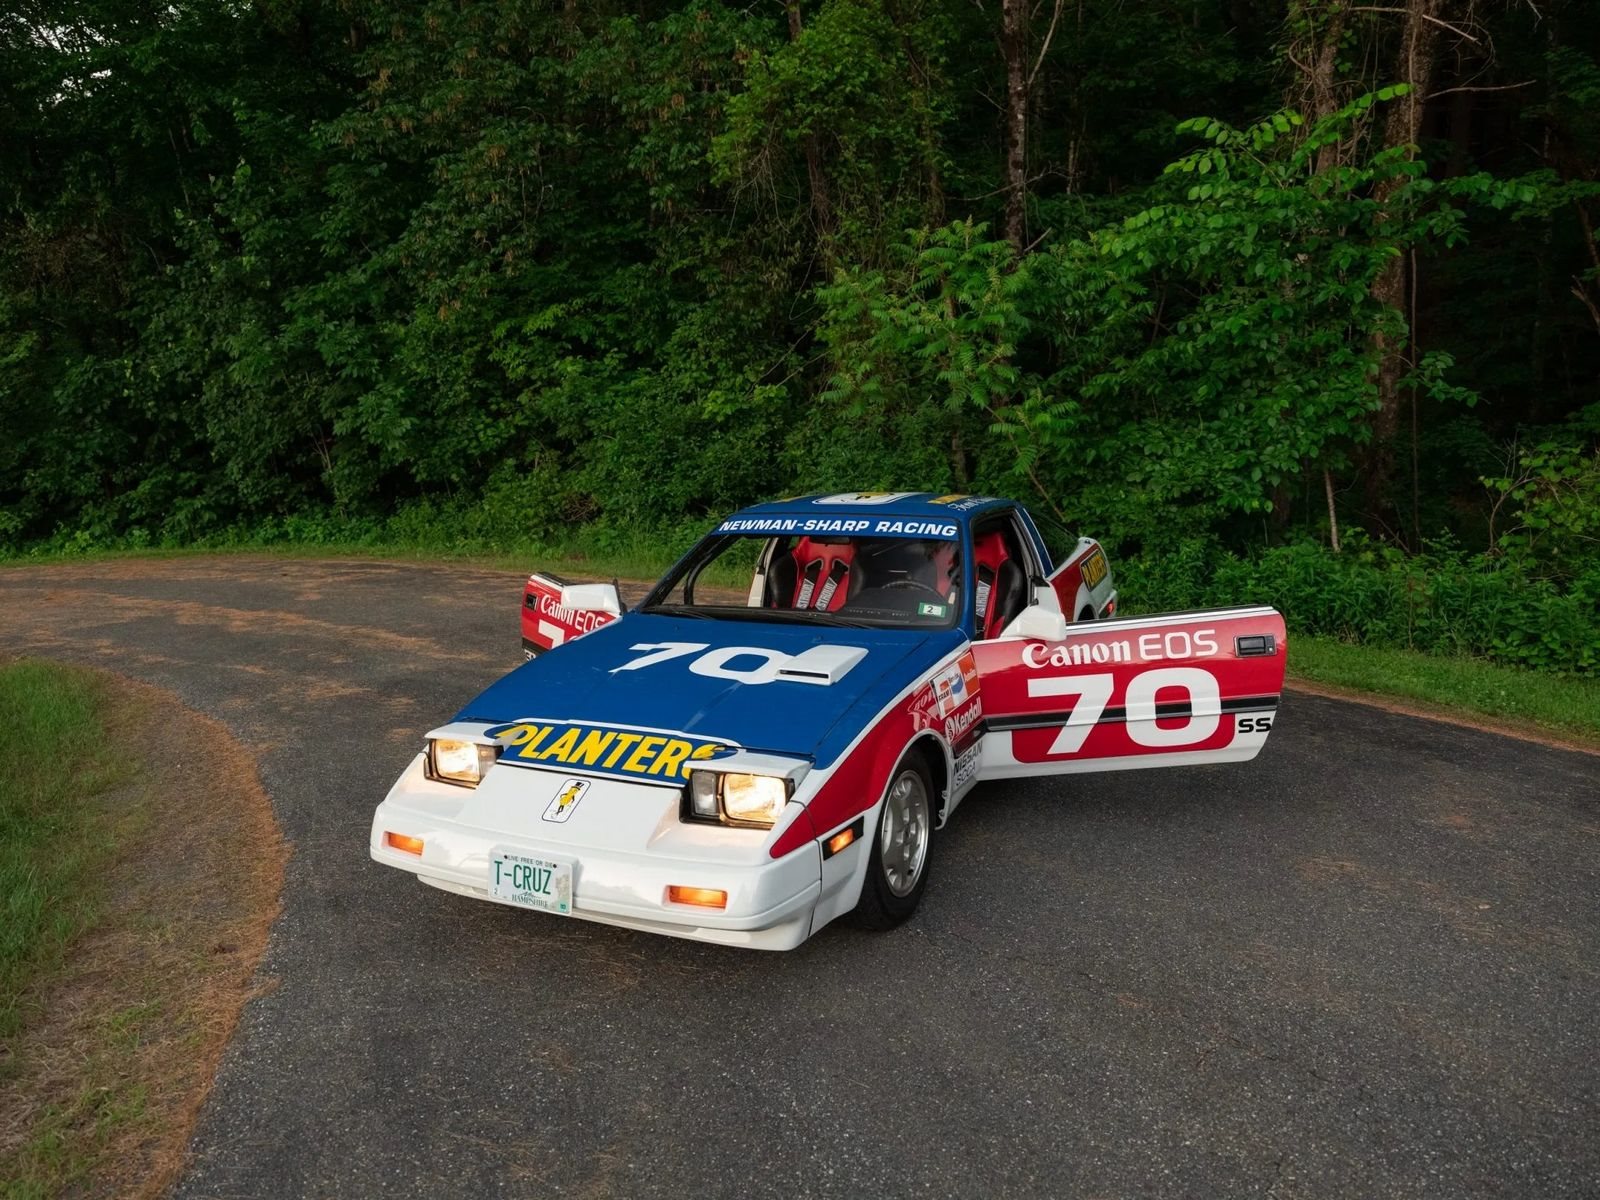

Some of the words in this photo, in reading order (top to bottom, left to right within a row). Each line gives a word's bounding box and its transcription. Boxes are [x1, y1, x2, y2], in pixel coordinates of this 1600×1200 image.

[719, 519, 869, 532] NEWMAN-SHARP
[875, 521, 958, 537] RACING
[540, 594, 575, 626] Canon
[607, 642, 797, 685] 70
[1022, 640, 1131, 669] Canon
[1138, 629, 1219, 661] EOS
[954, 696, 982, 735] Kendall
[1027, 667, 1222, 755] 70
[1238, 717, 1272, 734] SS
[953, 739, 983, 777] NISSAN
[494, 860, 552, 896] T-CRUZ
[520, 856, 533, 865] FREE
